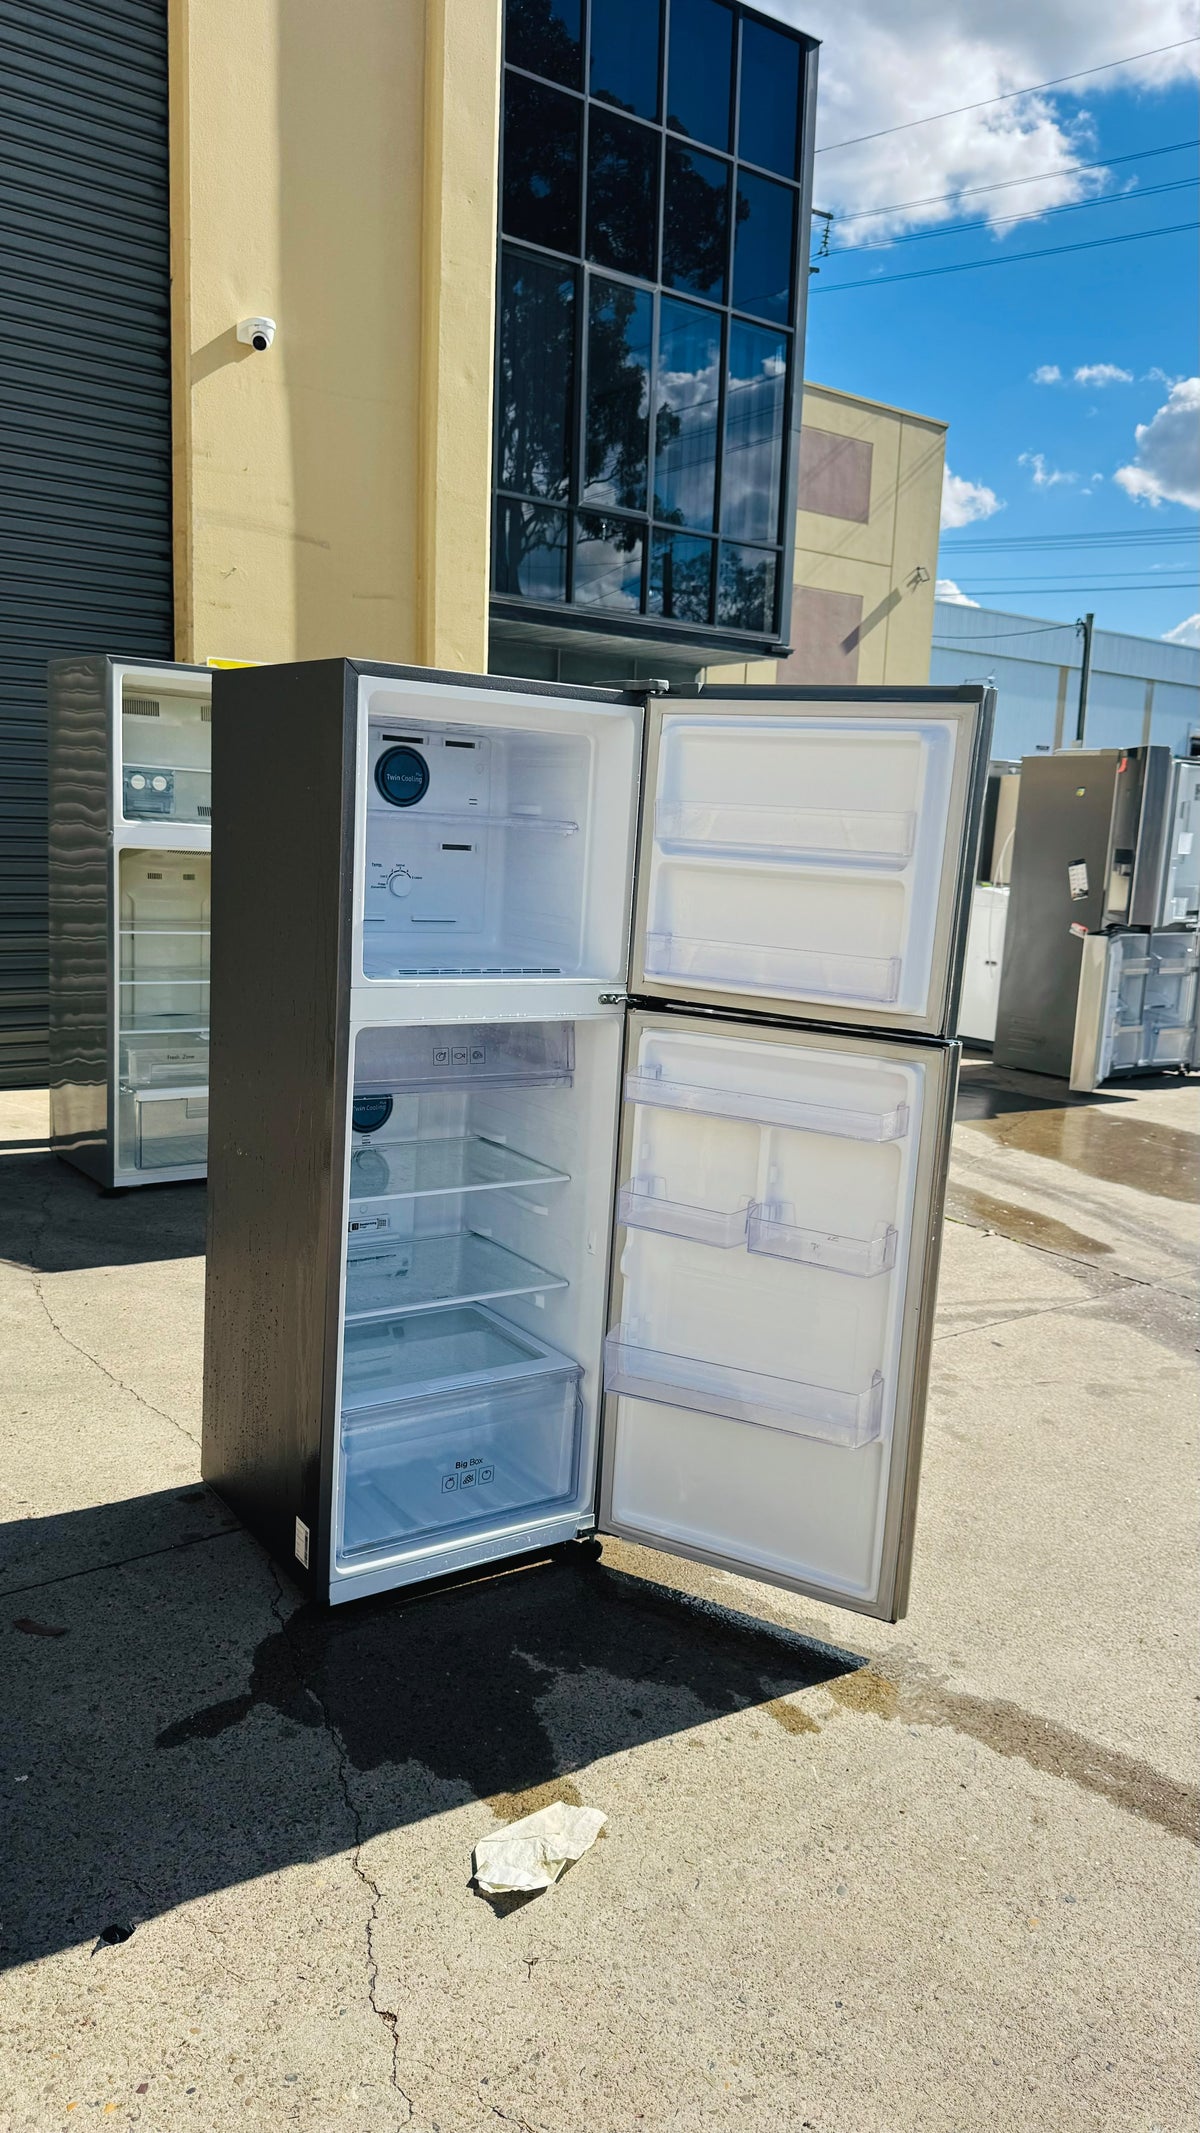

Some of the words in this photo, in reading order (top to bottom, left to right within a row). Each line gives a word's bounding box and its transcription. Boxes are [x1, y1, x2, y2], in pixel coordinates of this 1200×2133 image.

[386, 773, 401, 781] Twin
[401, 775, 423, 784] Cooling
[366, 1104, 386, 1112] Cooling
[455, 1461, 468, 1470] Big
[469, 1457, 484, 1467] Box
